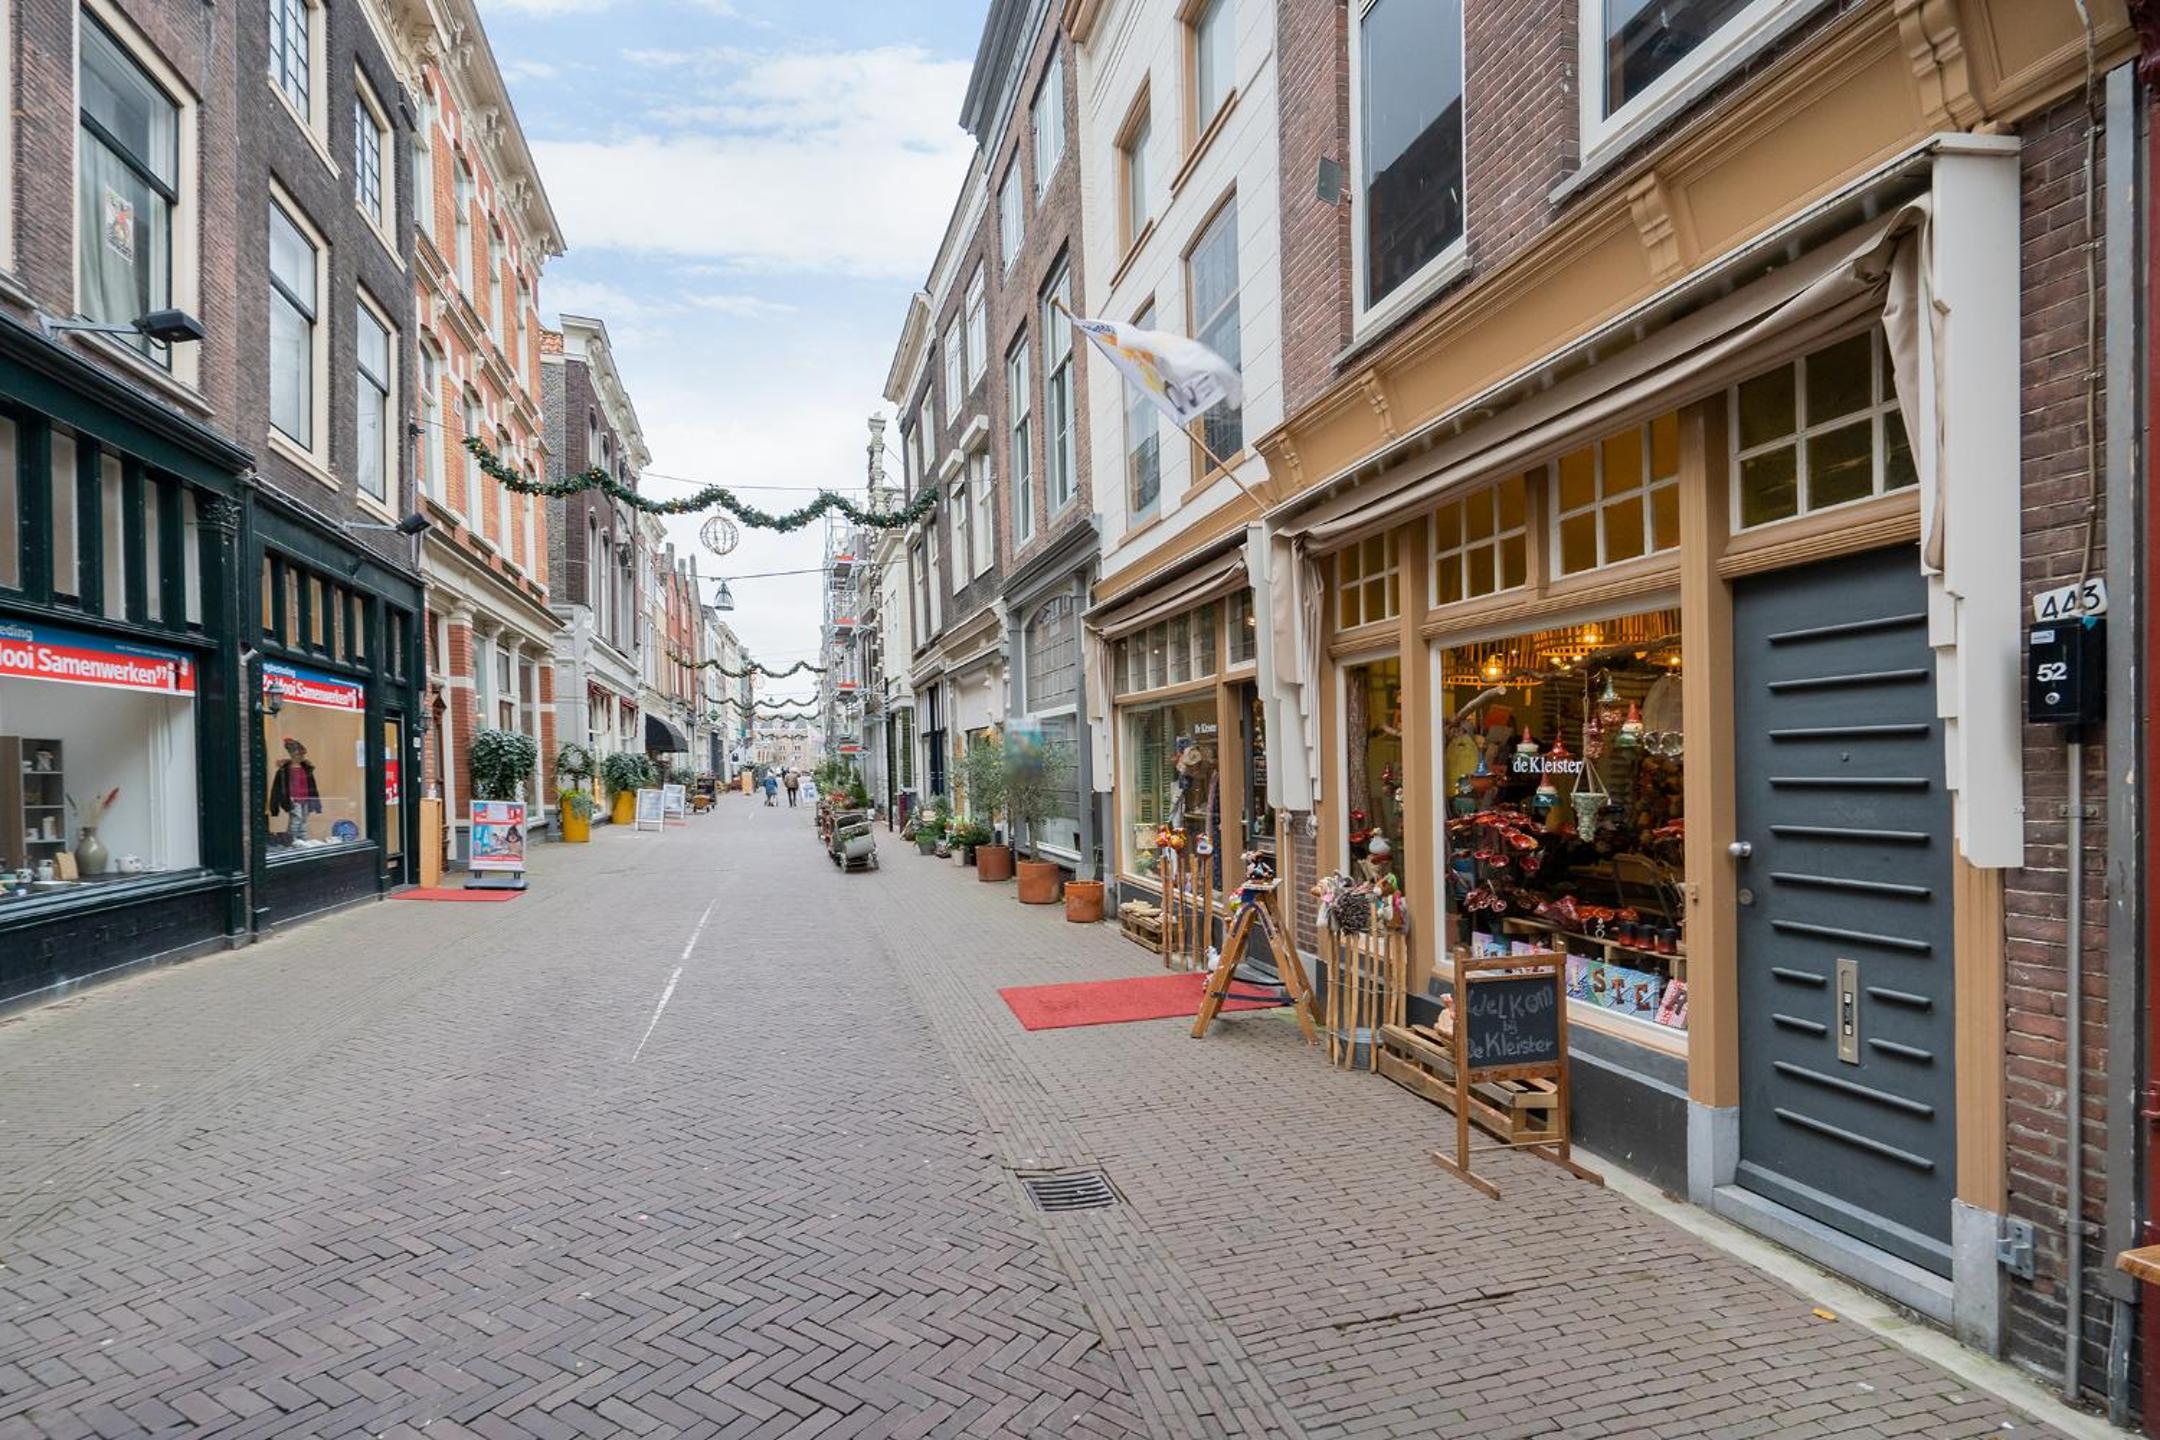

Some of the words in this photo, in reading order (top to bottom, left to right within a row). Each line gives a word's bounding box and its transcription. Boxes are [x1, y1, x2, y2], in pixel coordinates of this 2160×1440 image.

[0, 643, 34, 670] ooi
[2037, 662, 2068, 682] 52
[1513, 757, 1528, 773] de
[1529, 756, 1583, 774] Kleister
[1485, 1032, 1554, 1058] Kleister
